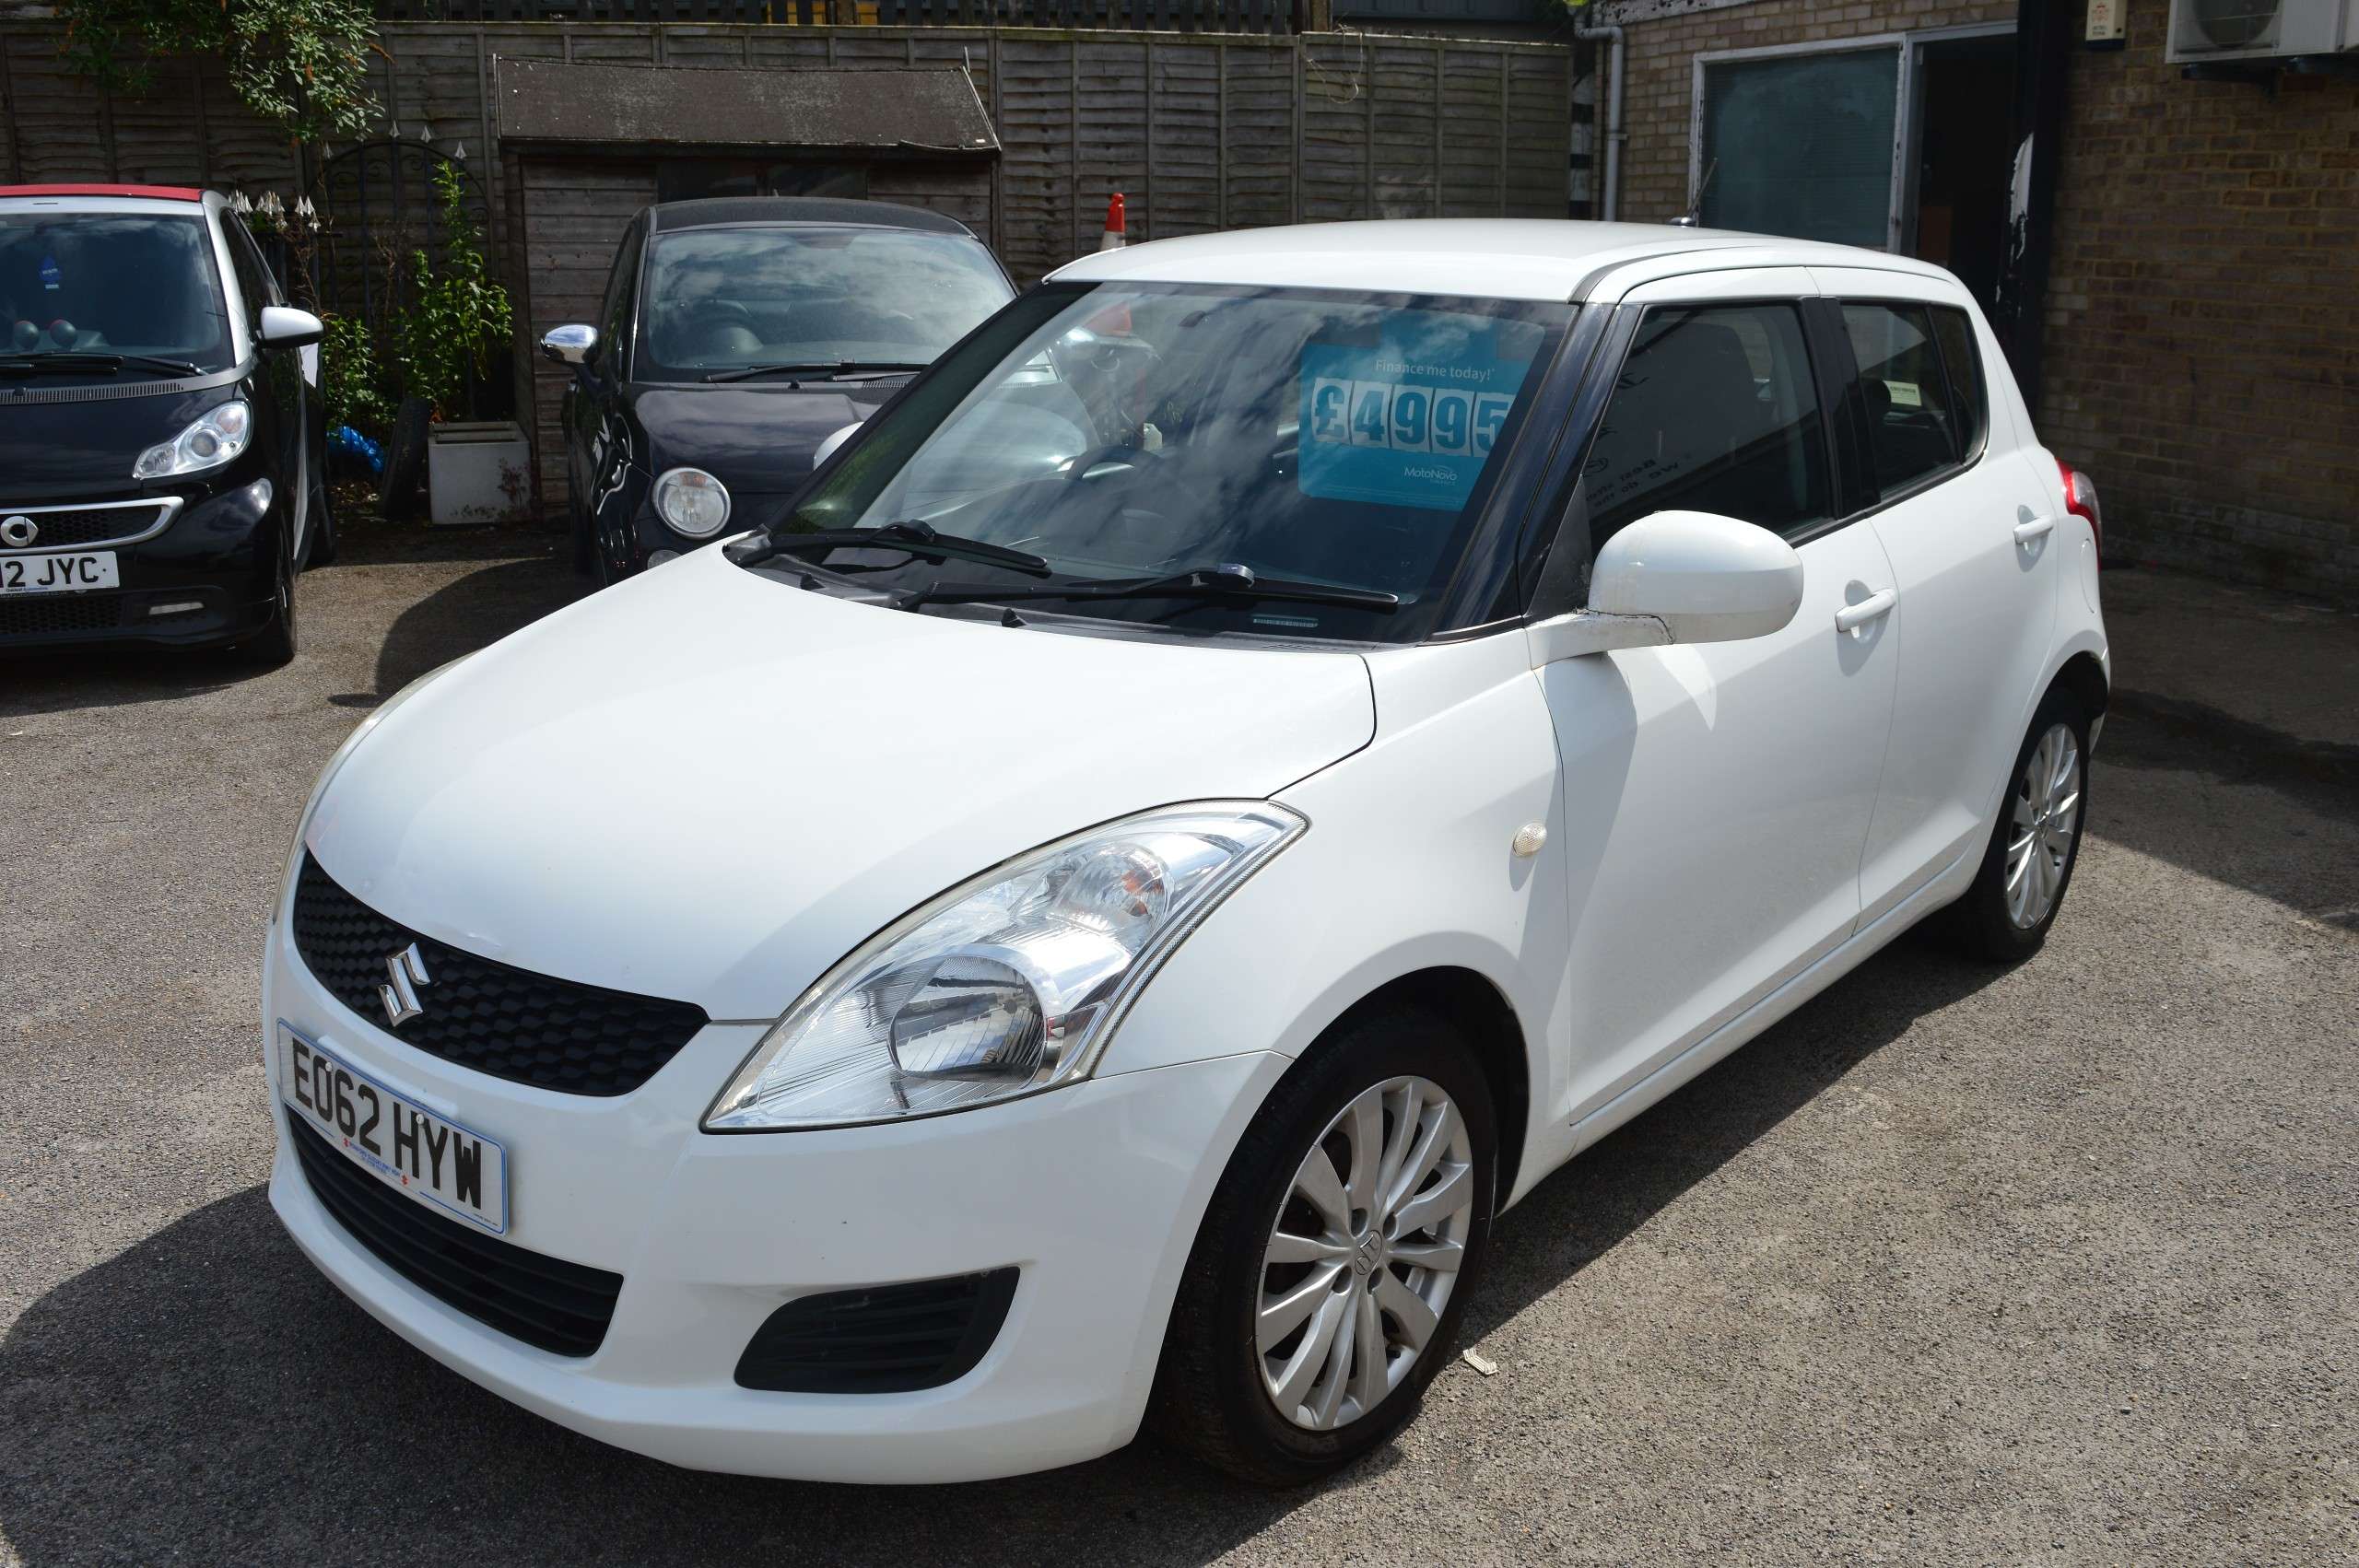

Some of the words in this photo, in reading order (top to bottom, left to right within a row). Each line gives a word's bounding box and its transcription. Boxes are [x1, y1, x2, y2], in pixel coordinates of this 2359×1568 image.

[1376, 358, 1424, 376] Finance
[1426, 366, 1447, 377] me
[1314, 384, 1509, 452] £4995
[1403, 465, 1458, 481] MotoNovo
[37, 556, 100, 586] JYC
[393, 1101, 482, 1210] HYW
